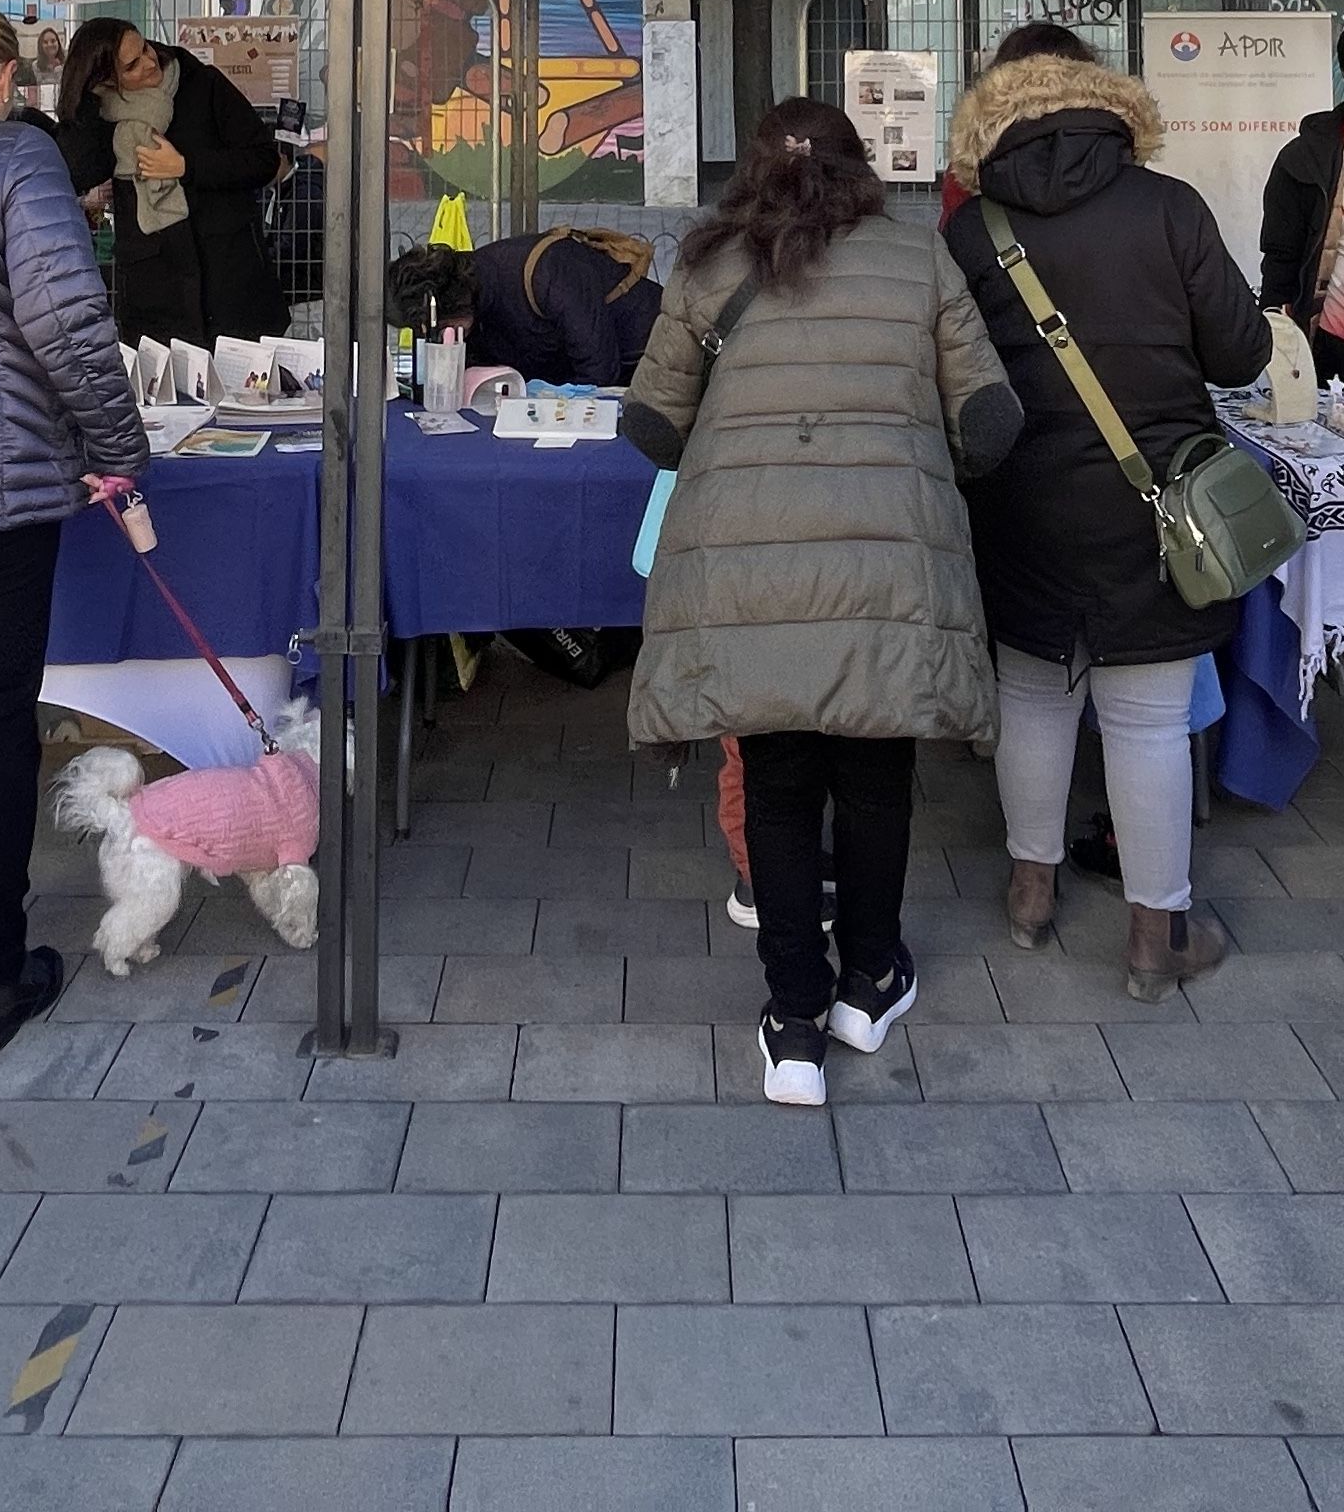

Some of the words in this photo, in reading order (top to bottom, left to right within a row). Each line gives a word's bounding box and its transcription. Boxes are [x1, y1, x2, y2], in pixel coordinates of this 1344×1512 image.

[1218, 31, 1286, 58] APDIR
[1163, 120, 1196, 132] TOTS
[1201, 120, 1232, 132] SOM
[1238, 120, 1297, 132] DIFEREN
